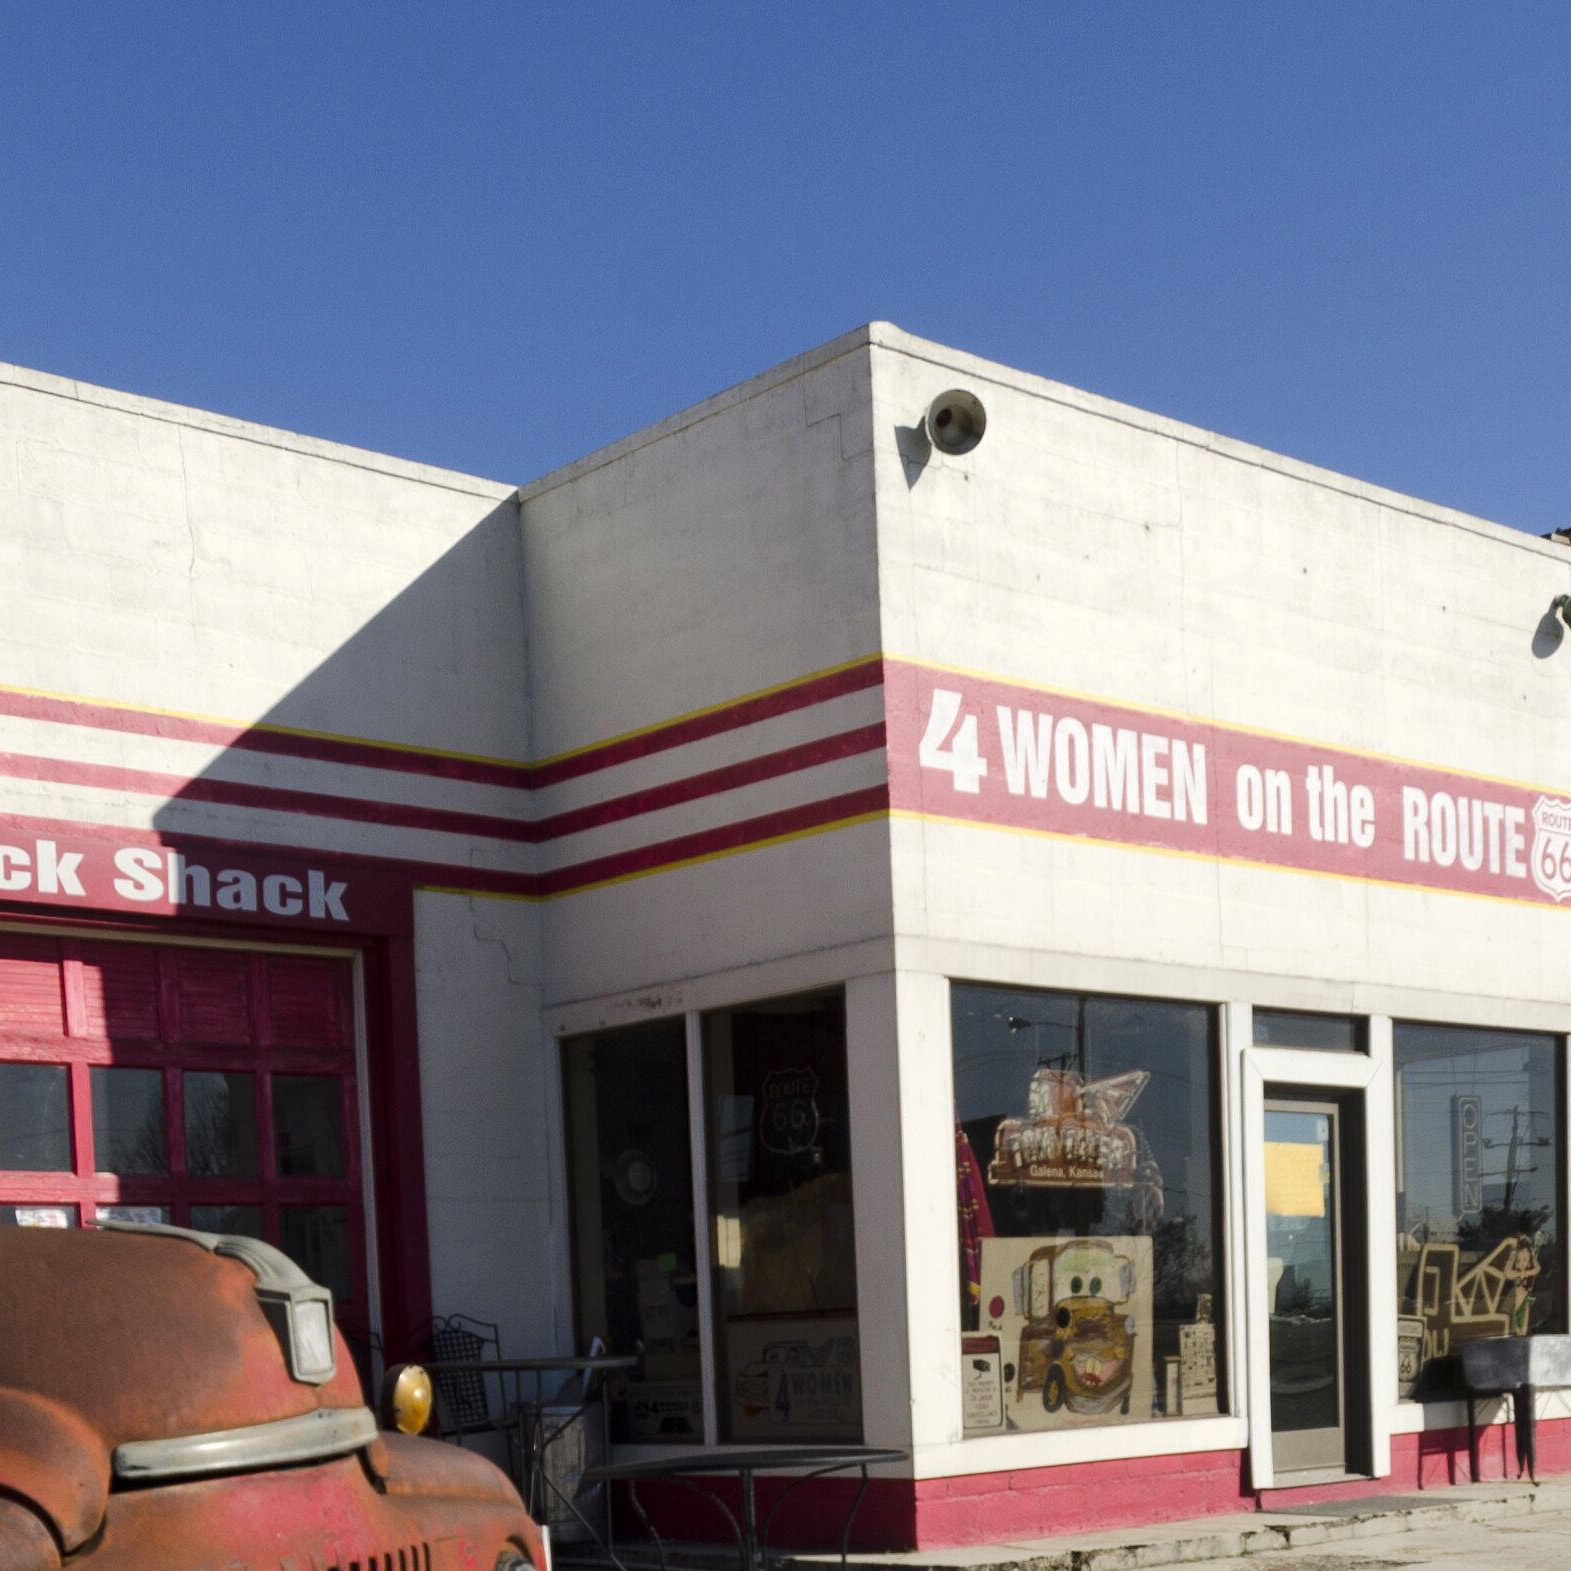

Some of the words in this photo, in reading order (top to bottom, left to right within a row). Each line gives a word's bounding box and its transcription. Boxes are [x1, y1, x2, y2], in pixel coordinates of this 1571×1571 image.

[918, 688, 987, 794] 4
[996, 704, 1208, 825] WOMEN
[1236, 763, 1292, 834] on
[1306, 765, 1375, 848] the
[1403, 786, 1527, 879] ROUTE
[113, 846, 350, 922] Shack
[773, 1099, 805, 1131] 66
[1030, 1164, 1065, 1179] Galena,
[1069, 1166, 1104, 1178] Kansas
[1464, 1103, 1479, 1208] OPEN
[1400, 1359, 1413, 1374] 66
[792, 1372, 853, 1395] WOMEN
